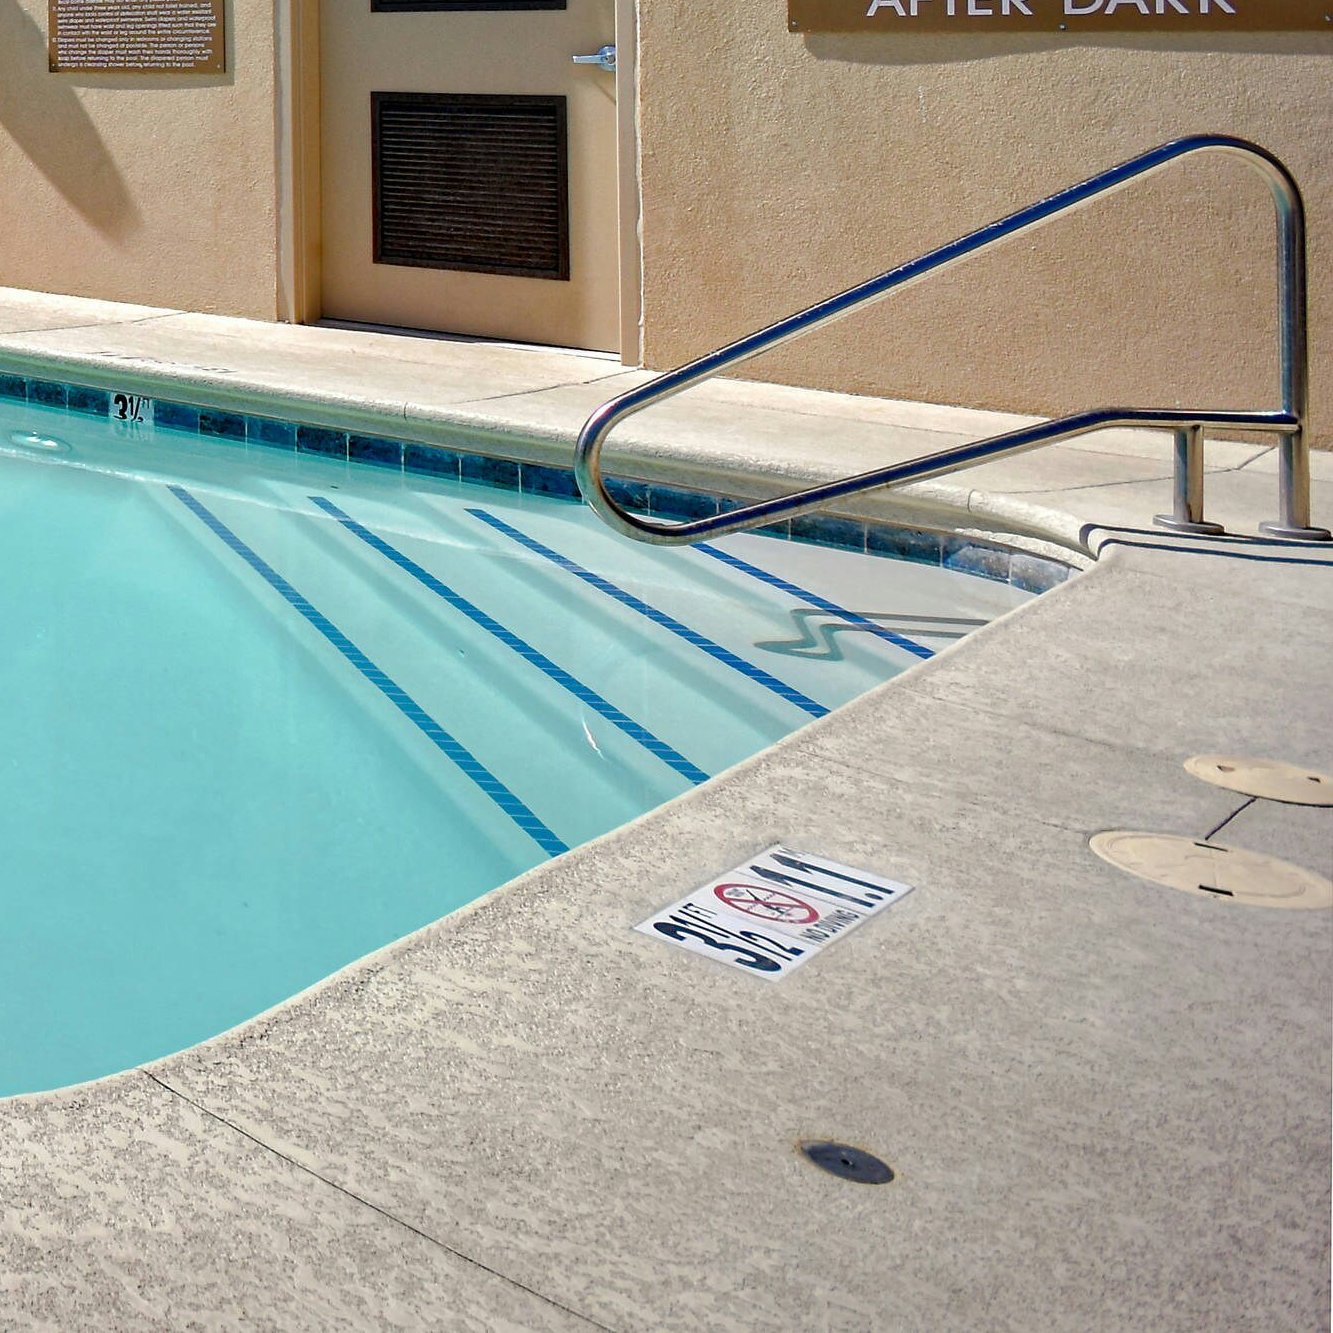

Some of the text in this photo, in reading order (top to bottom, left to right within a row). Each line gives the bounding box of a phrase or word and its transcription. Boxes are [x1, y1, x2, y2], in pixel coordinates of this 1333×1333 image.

[750, 854, 895, 908] 1.1
[800, 909, 860, 943] NO DIVING
